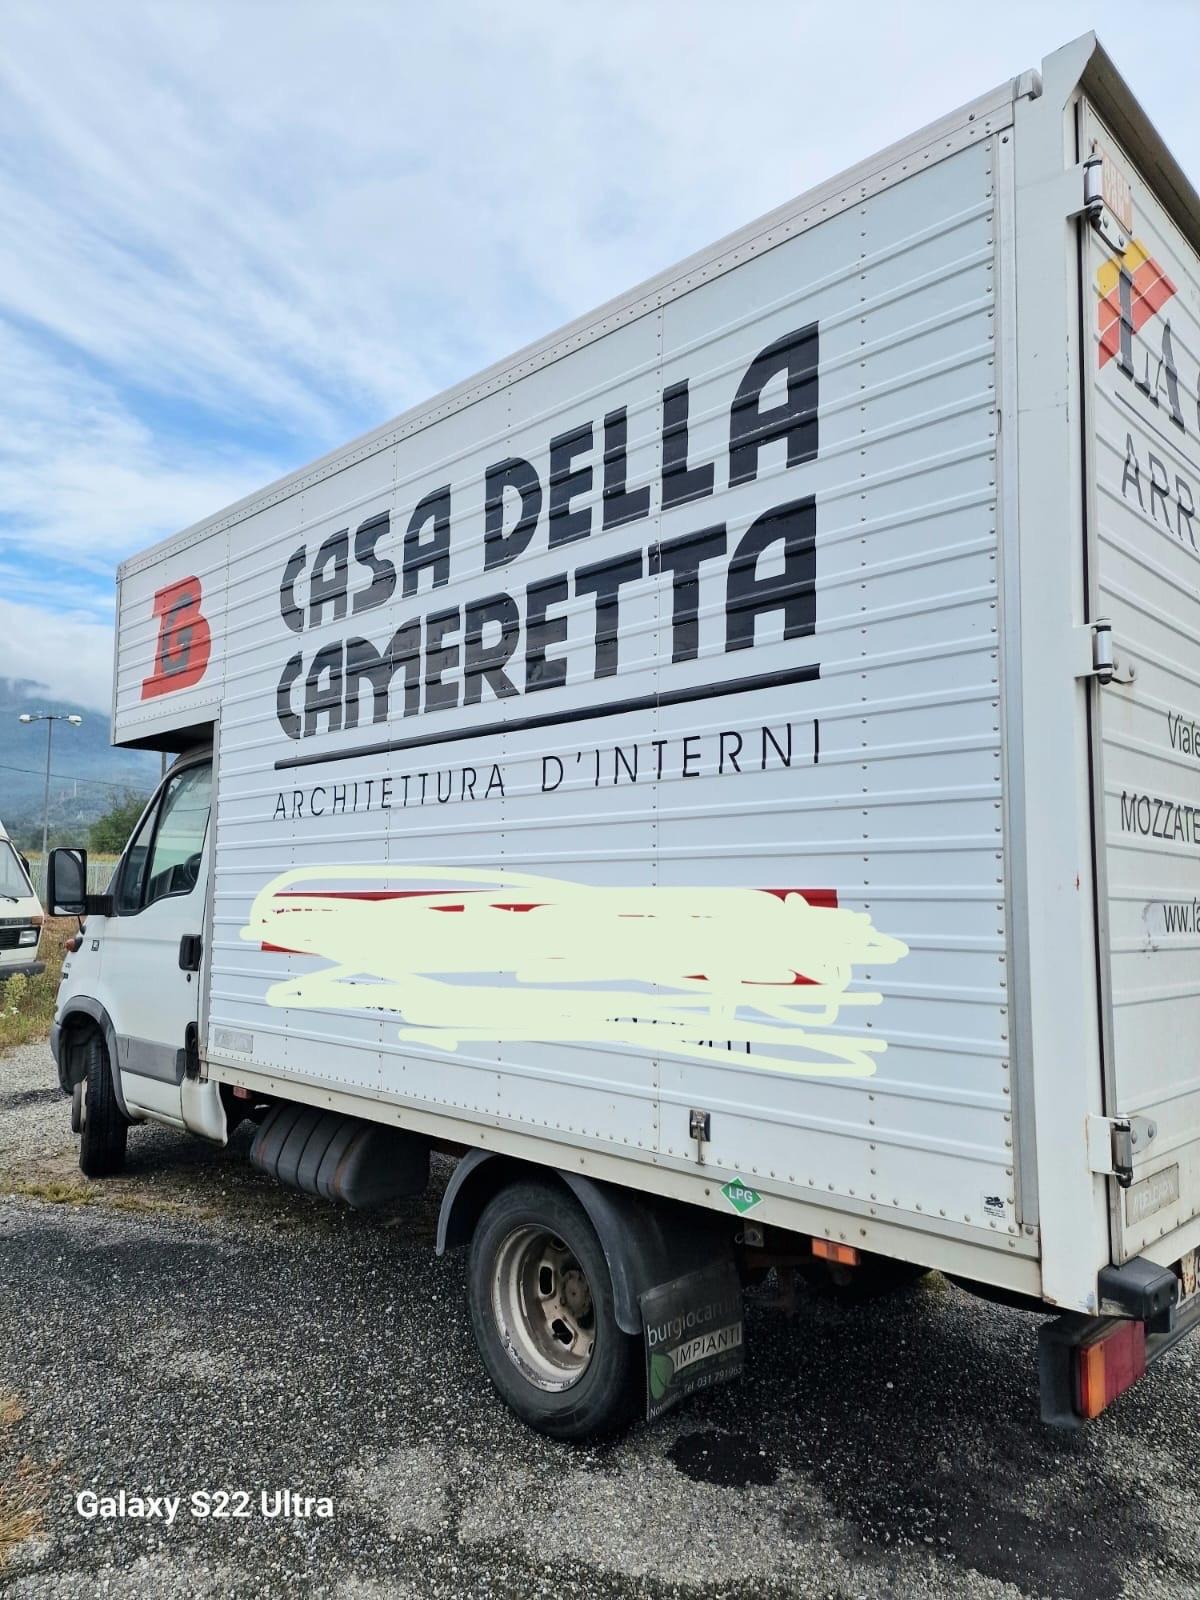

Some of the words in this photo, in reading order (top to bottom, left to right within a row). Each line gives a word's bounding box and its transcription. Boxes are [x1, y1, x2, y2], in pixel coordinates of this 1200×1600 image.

[280, 483, 451, 633] CASA
[484, 320, 819, 572] DELLA
[277, 494, 816, 741] CAMERETTA
[273, 763, 505, 820] ARCHITETTURA
[541, 718, 820, 792] D'INTERNI
[729, 1186, 753, 1203] LPG
[675, 1327, 740, 1367] IMPIANTI
